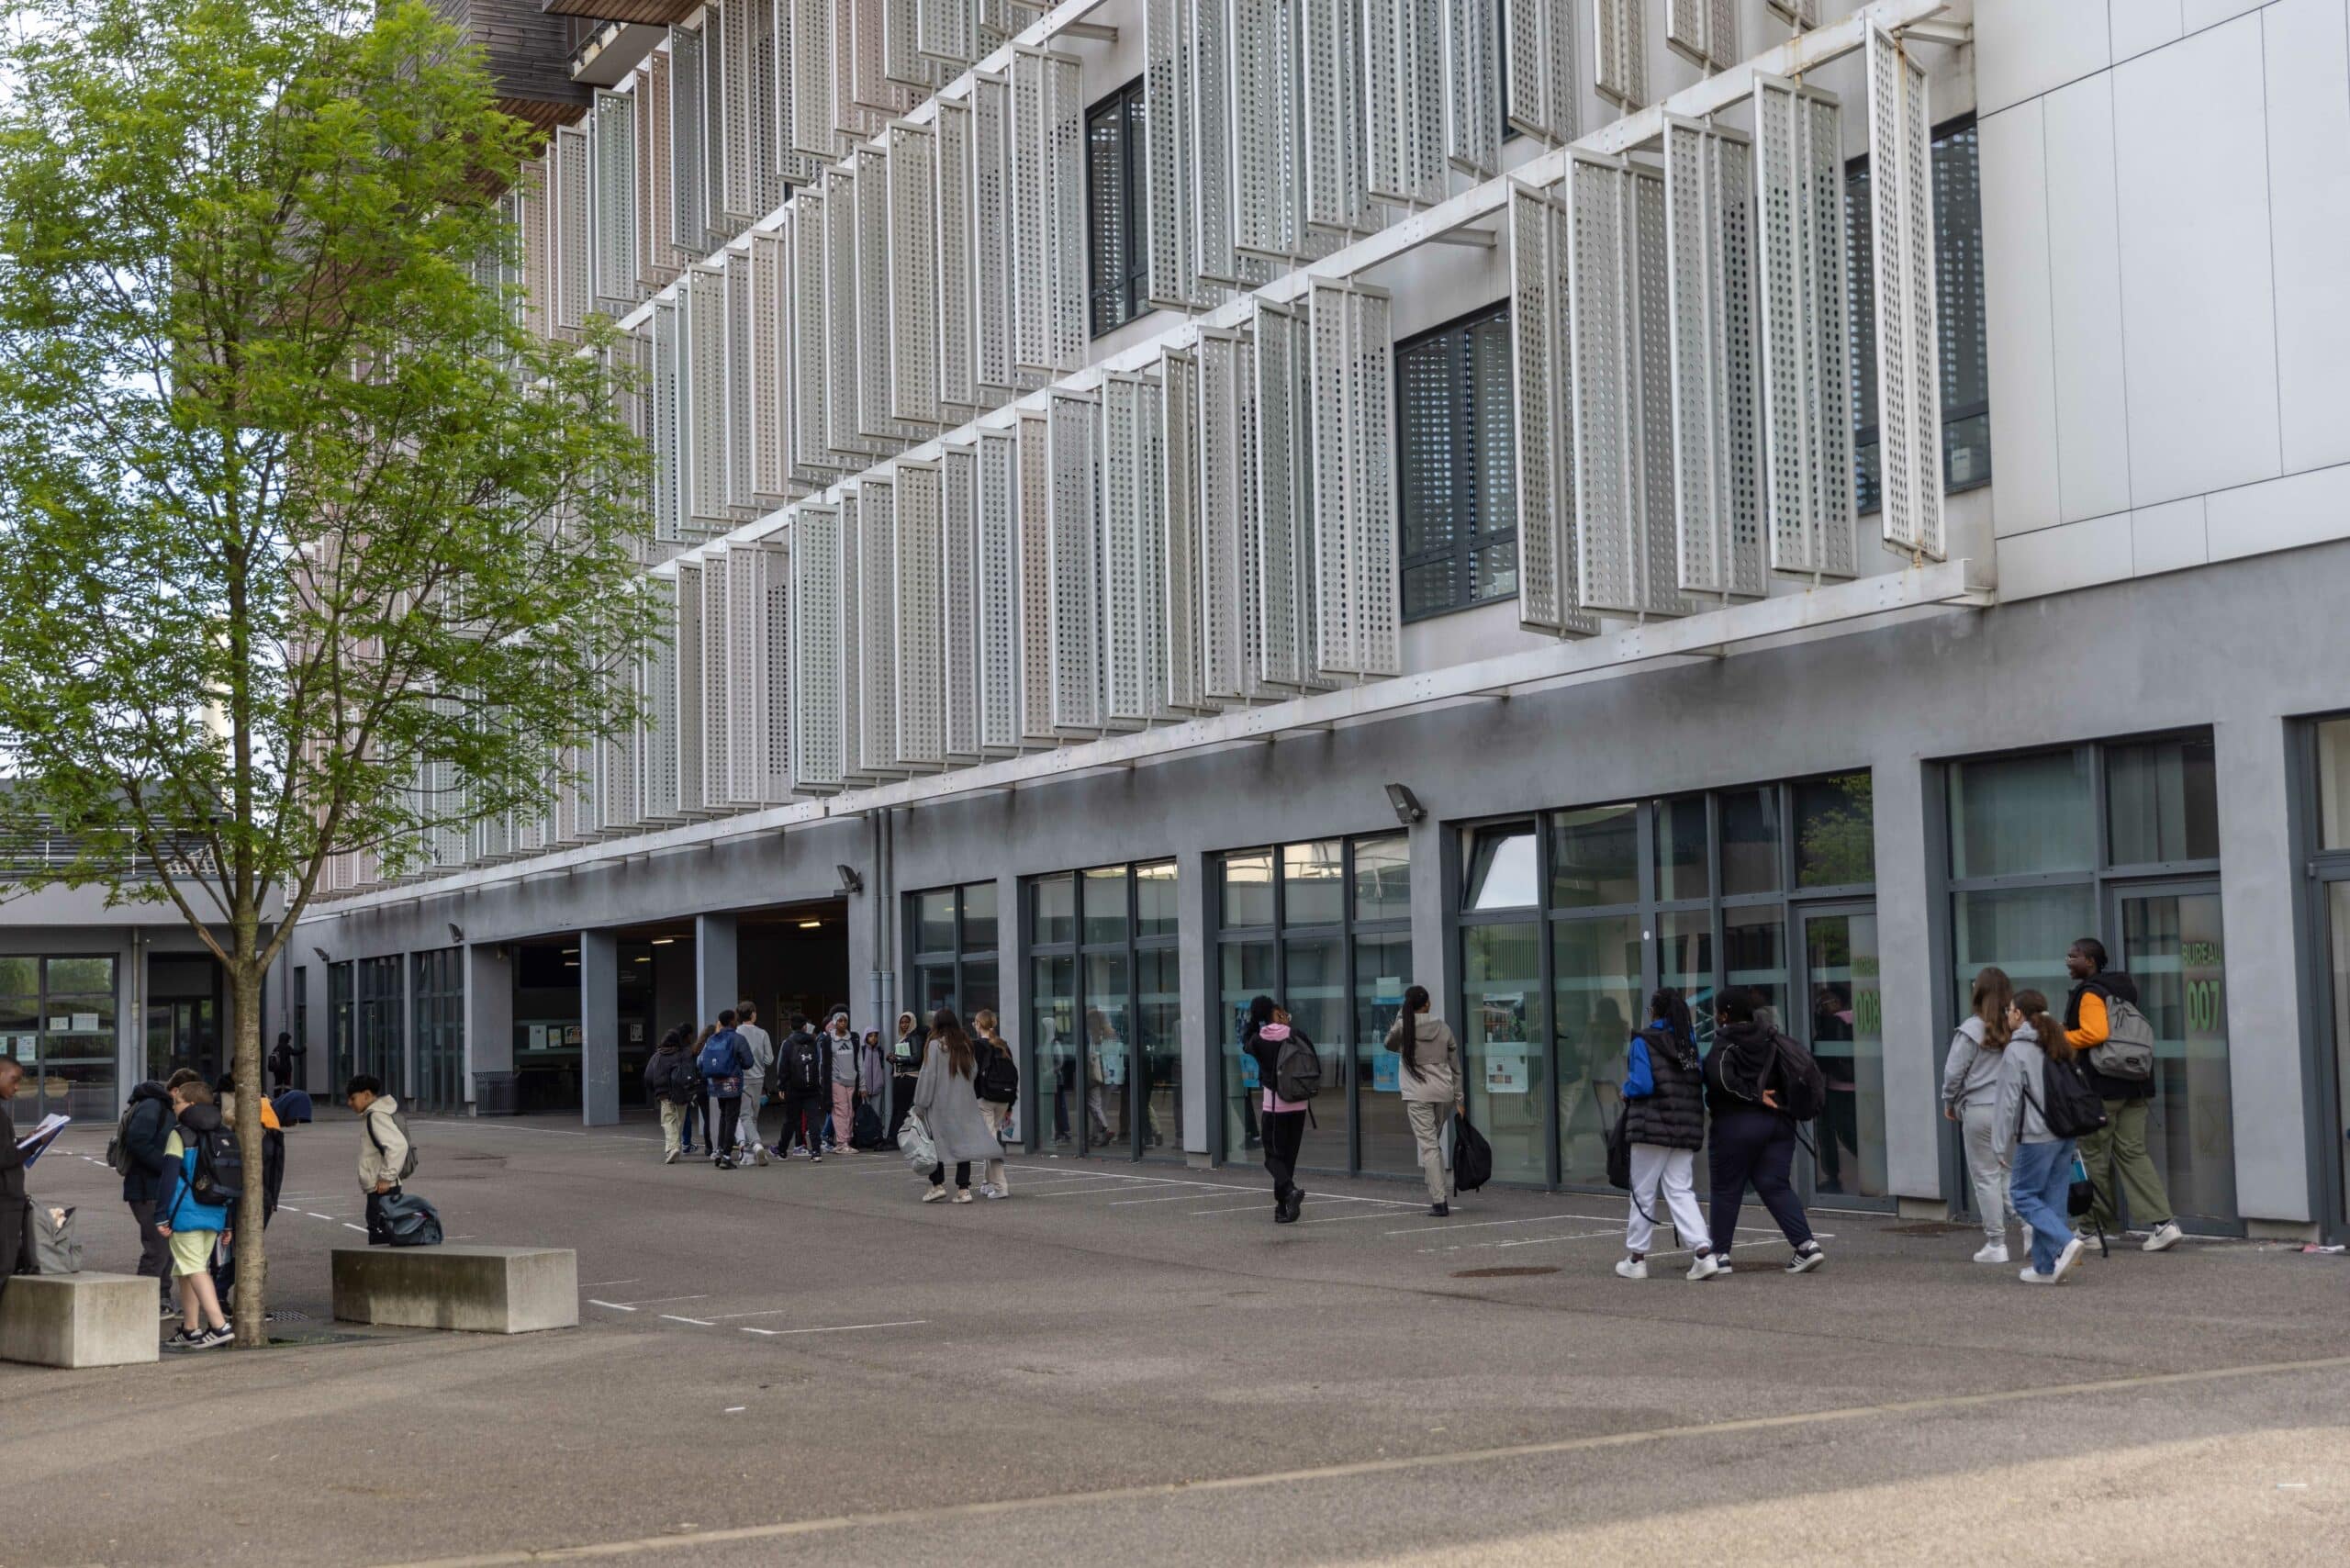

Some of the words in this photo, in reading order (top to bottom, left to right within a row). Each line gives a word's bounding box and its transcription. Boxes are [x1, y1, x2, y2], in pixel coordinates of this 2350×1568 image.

[2182, 943, 2221, 966] BUREAU
[1855, 991, 1880, 1032] 008
[2188, 980, 2220, 1030] 007
